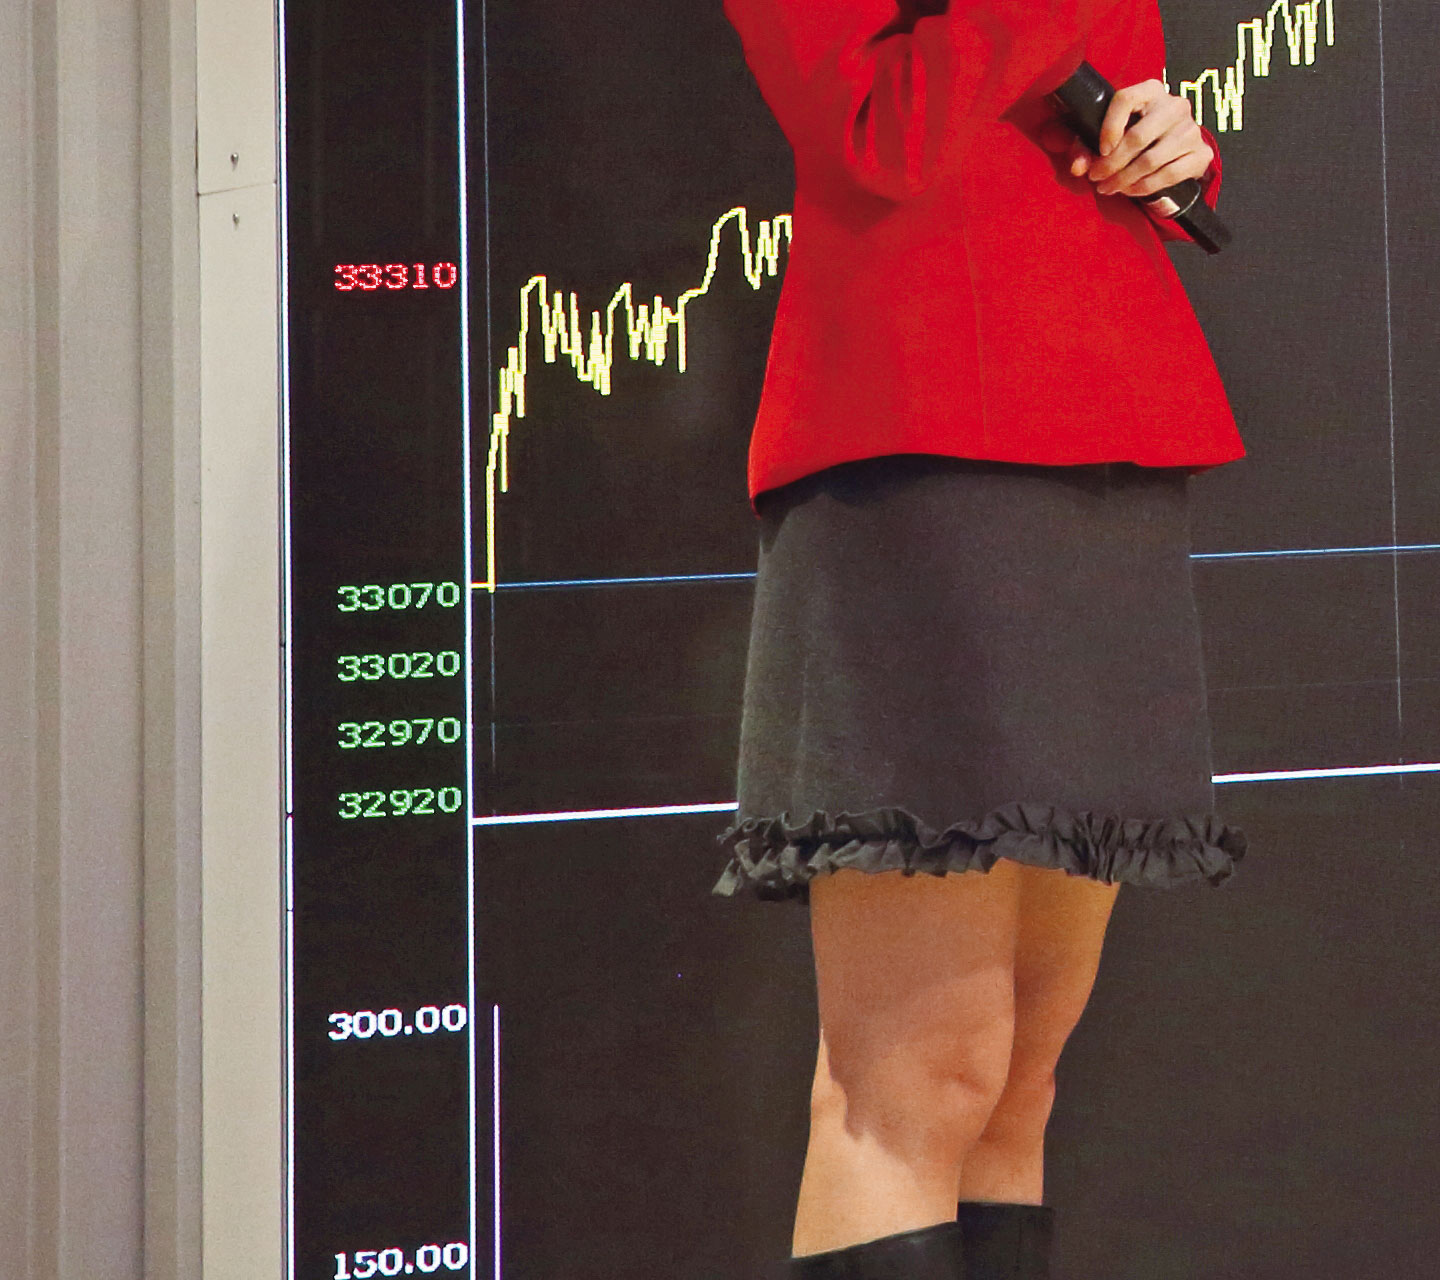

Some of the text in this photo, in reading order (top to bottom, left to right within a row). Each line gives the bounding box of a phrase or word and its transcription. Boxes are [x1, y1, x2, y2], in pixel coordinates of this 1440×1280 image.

[334, 262, 457, 291] 33310
[338, 582, 460, 611] 33070
[338, 651, 460, 681] 33020
[338, 717, 460, 748] 32970
[339, 787, 461, 819] 32920
[328, 1003, 466, 1040] 300.00
[334, 1241, 468, 1280] 150.00
